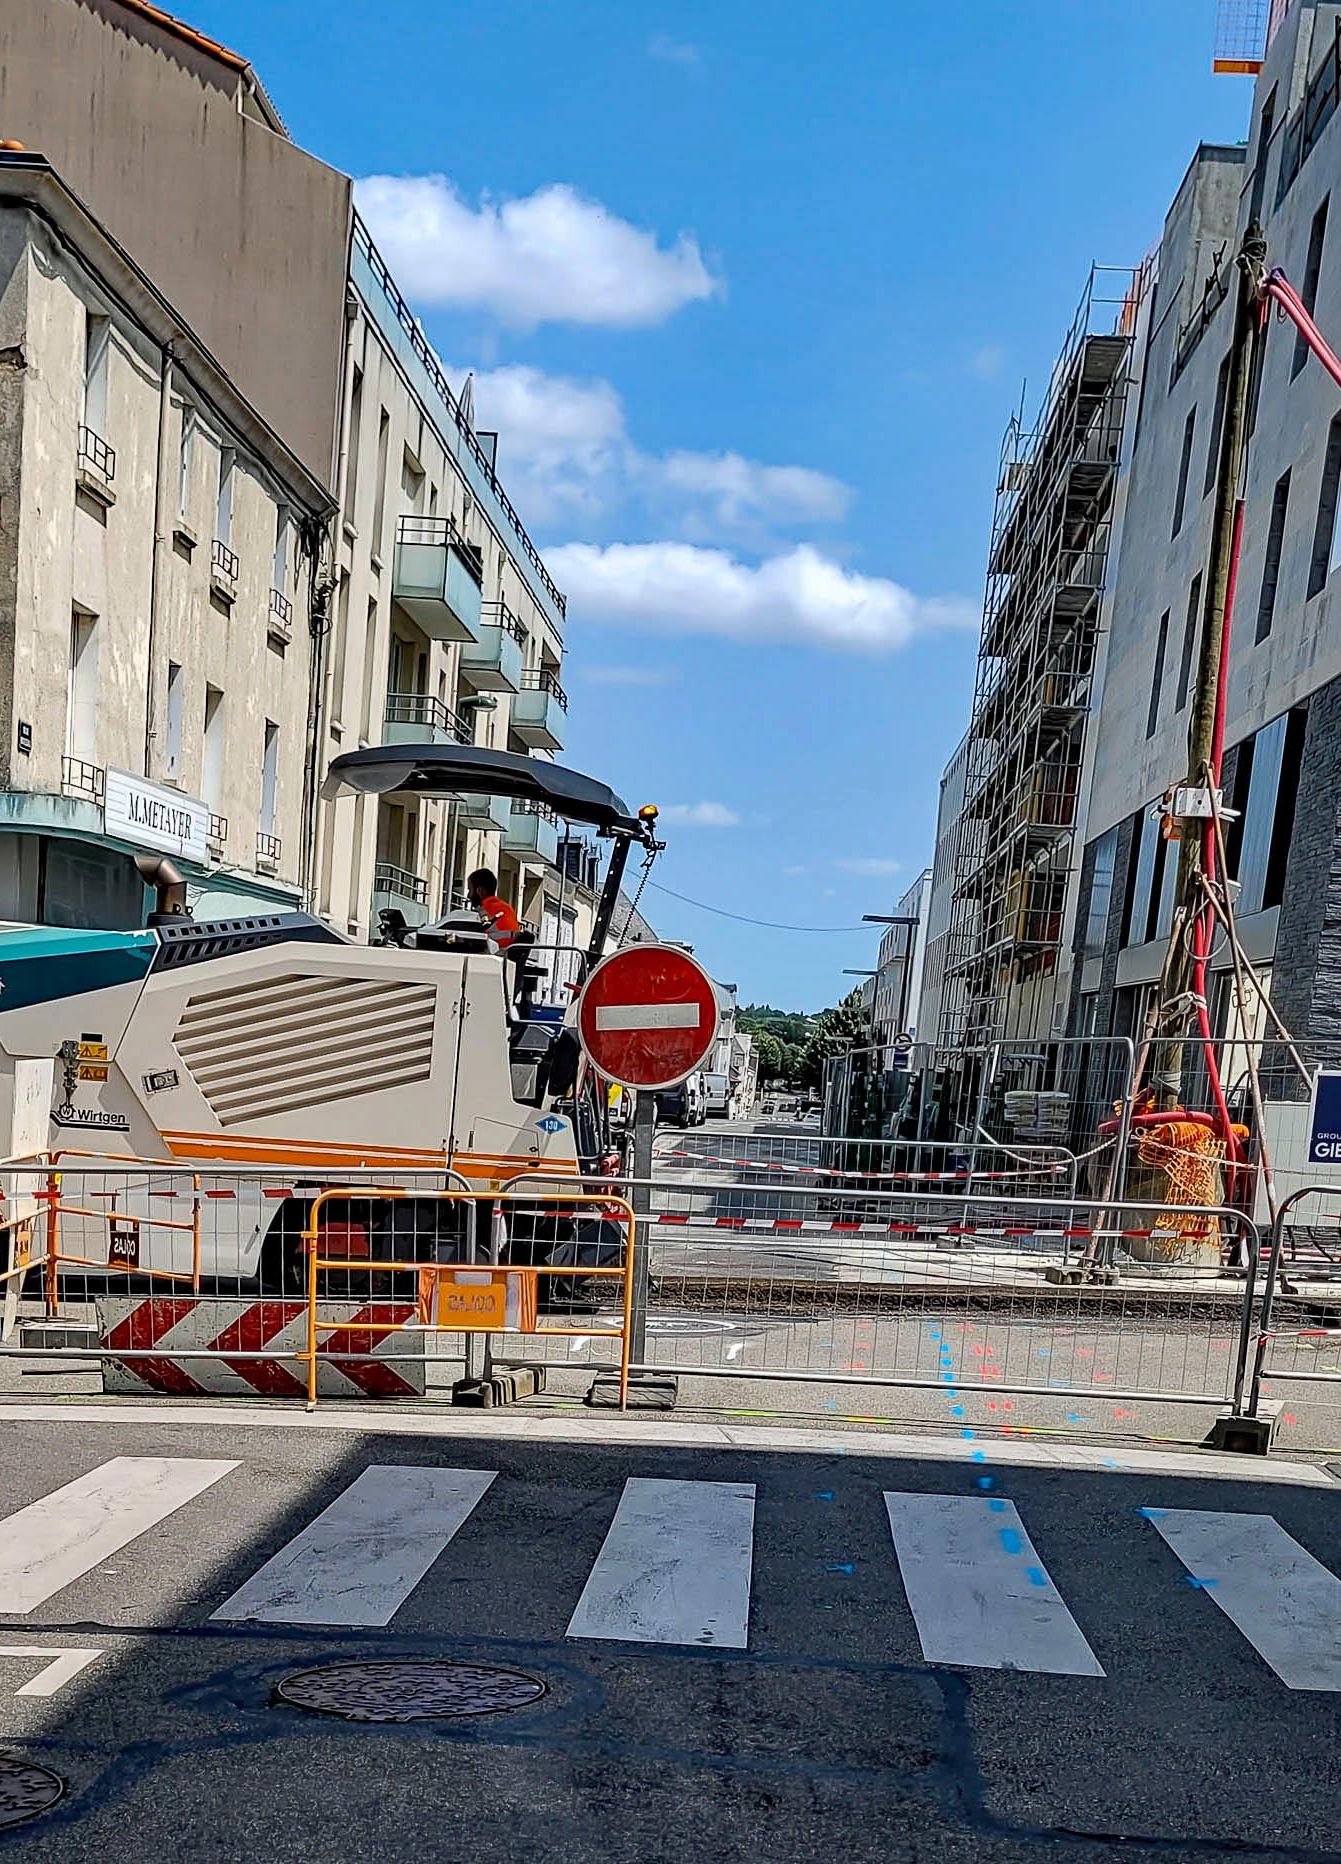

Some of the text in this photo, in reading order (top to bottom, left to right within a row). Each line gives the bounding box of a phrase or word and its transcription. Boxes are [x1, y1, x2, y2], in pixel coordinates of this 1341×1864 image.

[128, 792, 192, 840] M.METAYER
[77, 1109, 126, 1125] Wirtgen
[545, 1120, 559, 1131] 130
